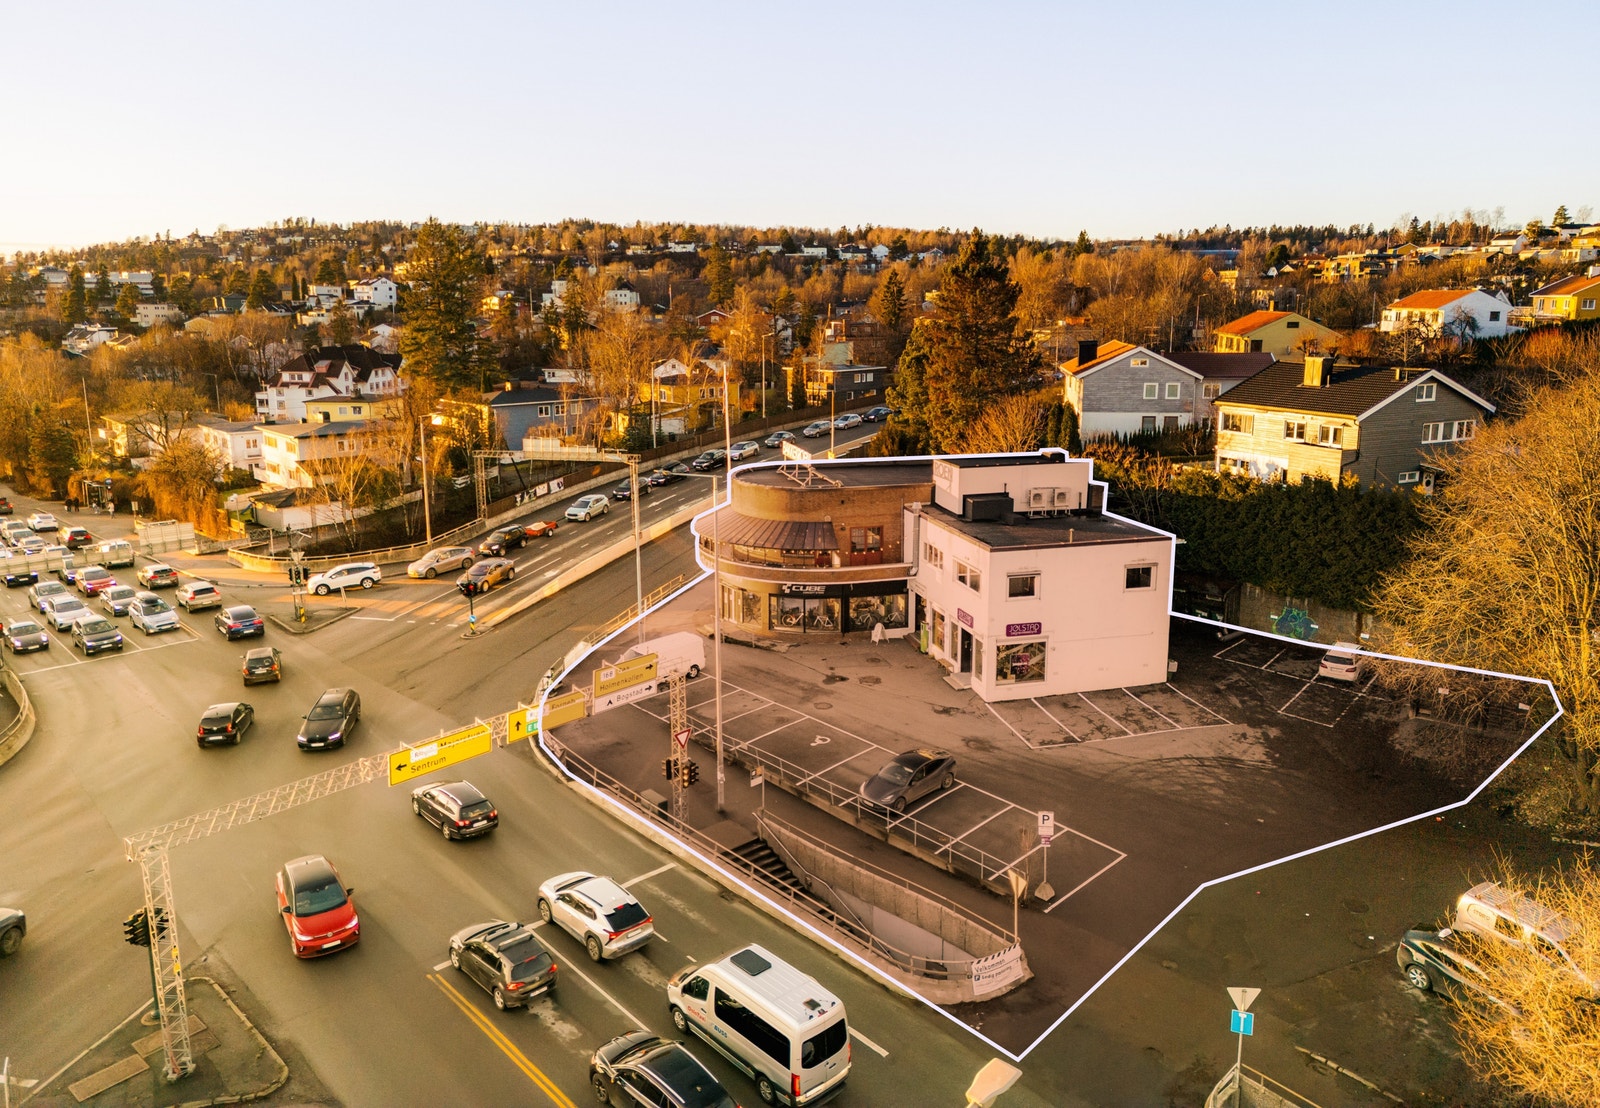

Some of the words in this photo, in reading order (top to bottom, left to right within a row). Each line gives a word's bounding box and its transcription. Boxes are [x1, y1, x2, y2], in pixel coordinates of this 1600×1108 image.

[600, 673, 644, 692] Holmenkollen
[603, 671, 614, 679] 168
[616, 687, 644, 702] Bogstad
[410, 756, 447, 774] Sentrum
[1042, 814, 1050, 824] P
[974, 958, 1006, 973] Velkommen
